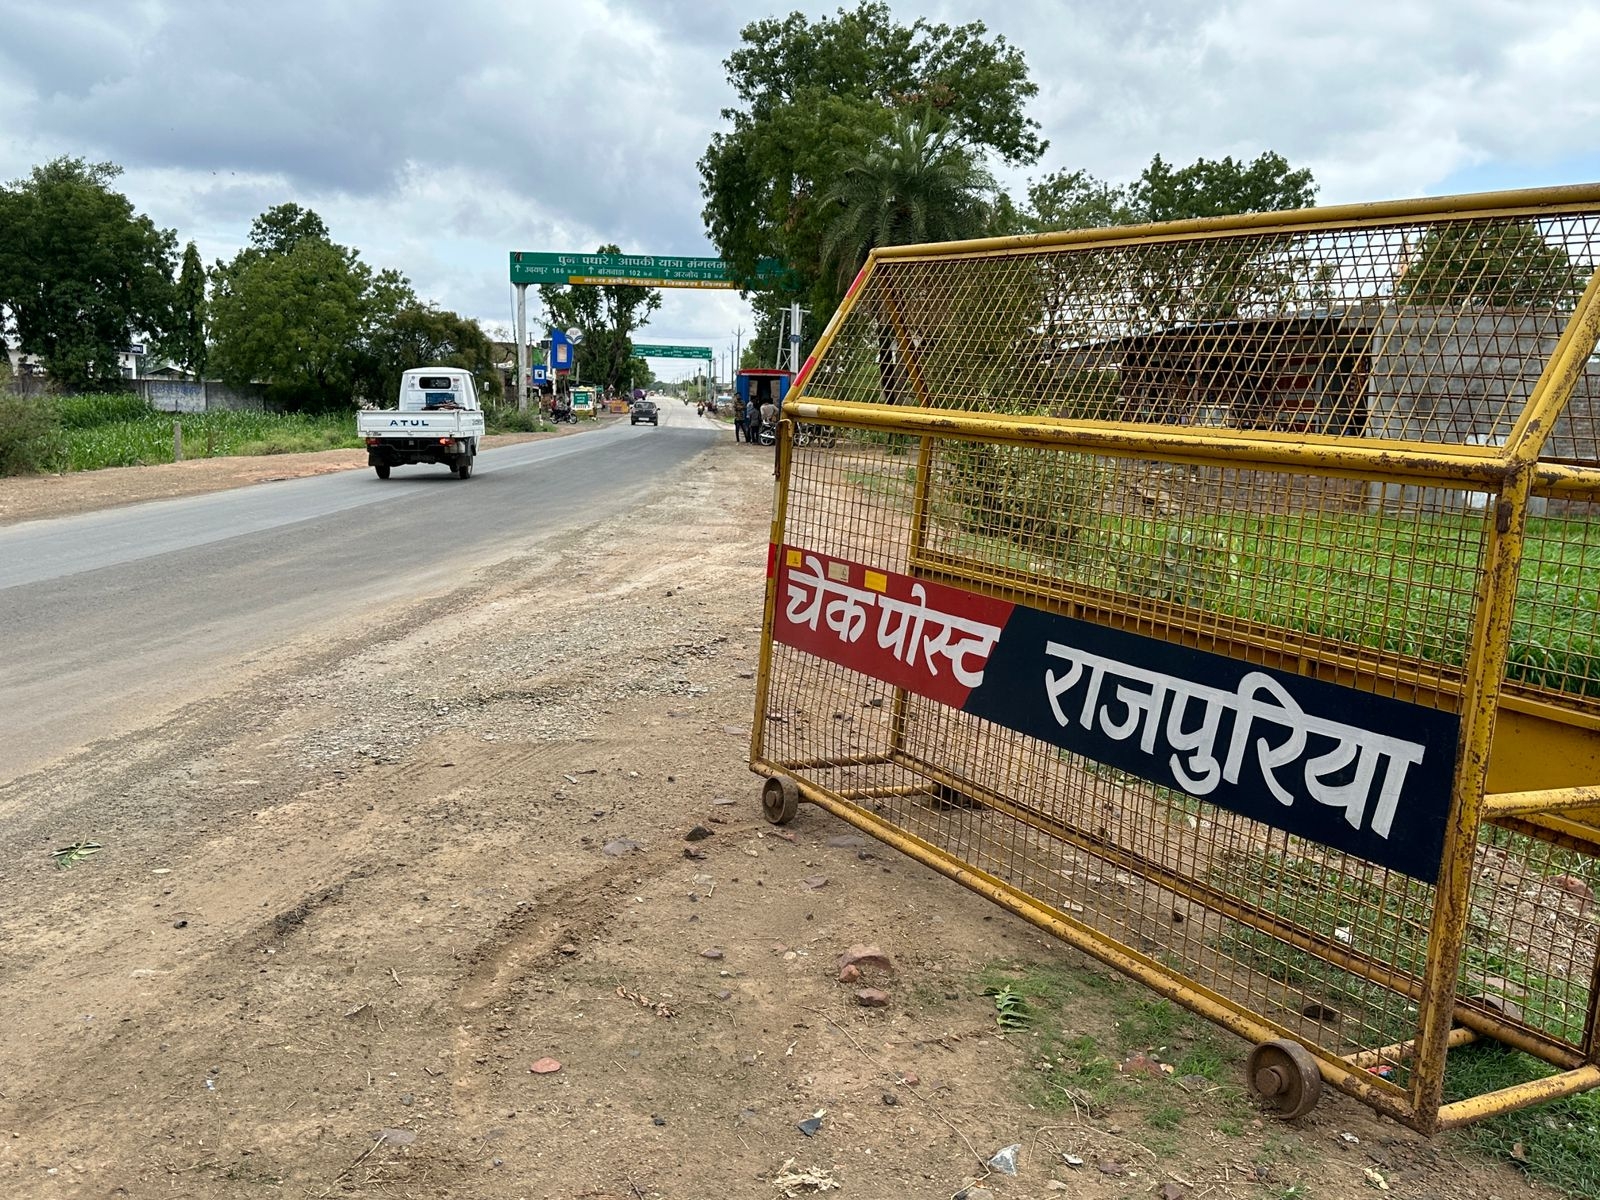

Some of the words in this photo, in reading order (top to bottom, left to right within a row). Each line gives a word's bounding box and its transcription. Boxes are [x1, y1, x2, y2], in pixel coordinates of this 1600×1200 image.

[618, 256, 655, 266] आपकी
[658, 258, 683, 267] यात्रा
[629, 269, 641, 277] 102
[389, 419, 430, 427] ATUL
[786, 555, 877, 643] चेक
[877, 583, 1002, 688] पोस्ट
[1045, 640, 1426, 839] राजपुरिया
